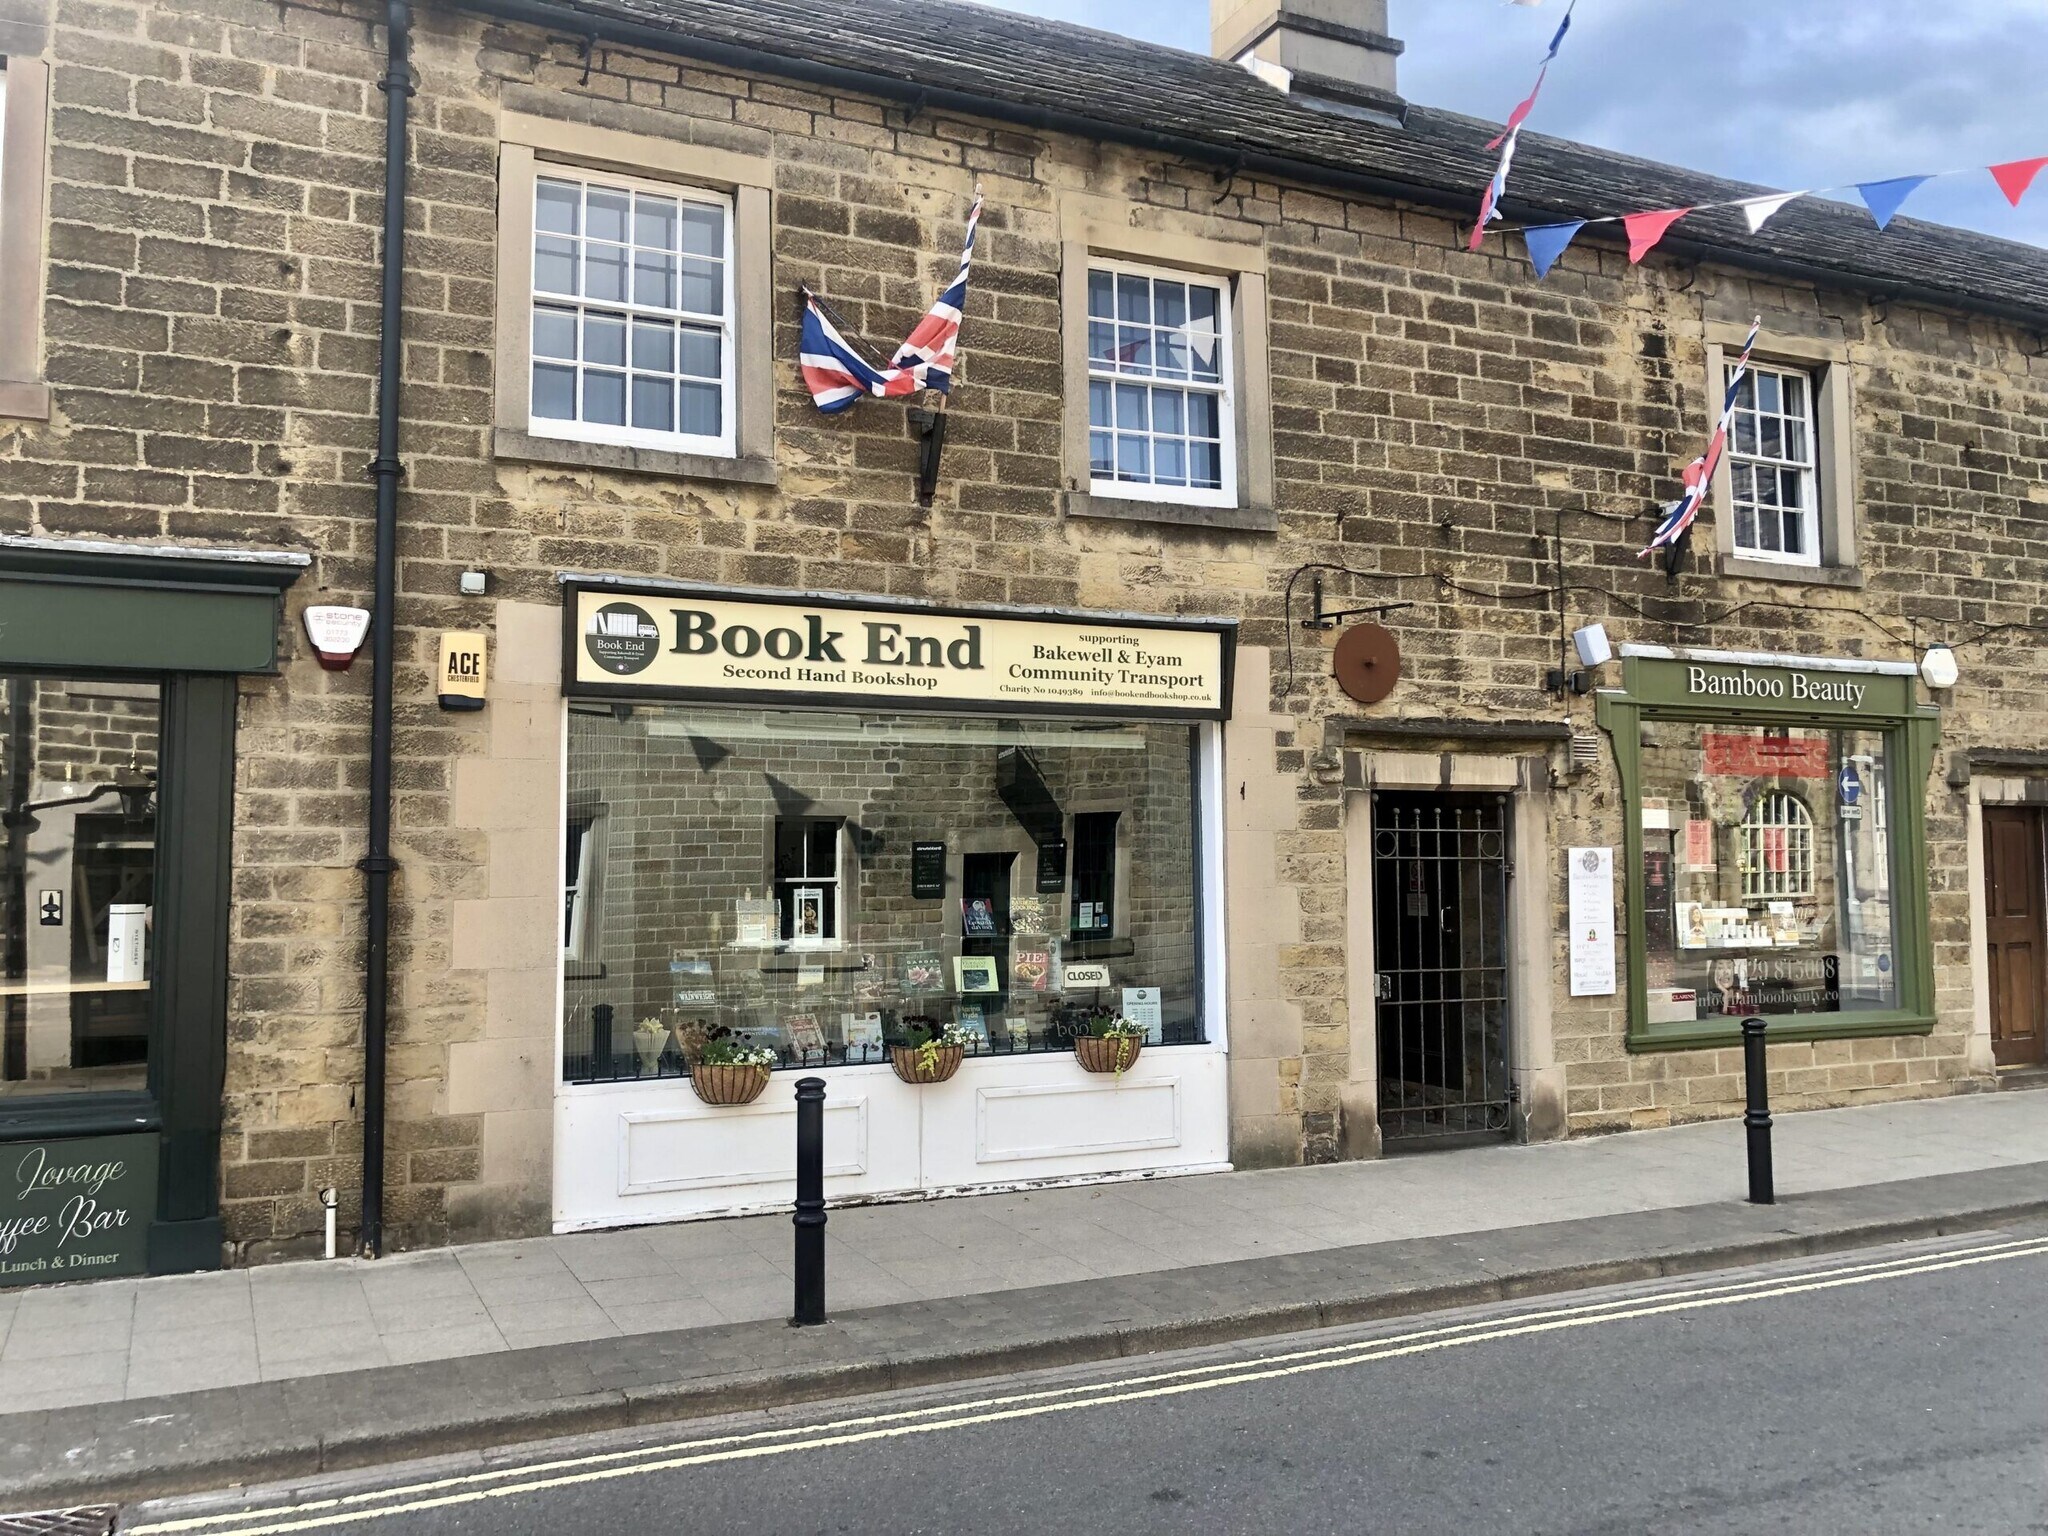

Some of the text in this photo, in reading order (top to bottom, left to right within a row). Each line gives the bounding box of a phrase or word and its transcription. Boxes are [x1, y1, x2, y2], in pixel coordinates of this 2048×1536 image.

[326, 612, 362, 621] stone
[597, 639, 645, 651] Book End
[668, 608, 986, 671] Book End
[1078, 634, 1140, 646] supporting
[448, 652, 480, 675] ACE
[1033, 645, 1182, 669] Bakewell & Eyam
[447, 674, 479, 684] CHESTERFIELD
[723, 664, 938, 690] Second Hand Bookshop
[1008, 664, 1205, 689] Community Transport
[1688, 666, 1866, 710] Bamboo Beauty
[999, 684, 1212, 702] Charity No 1049389 info@bookendbookshop.co.uk
[1704, 742, 1828, 770] CLARINS
[1067, 971, 1103, 981] CLOSED
[1774, 957, 1835, 981] 815008
[16, 1147, 128, 1201] Lovage
[57, 1195, 131, 1249] Bar
[1, 1253, 120, 1274] Lunch & Dinner
